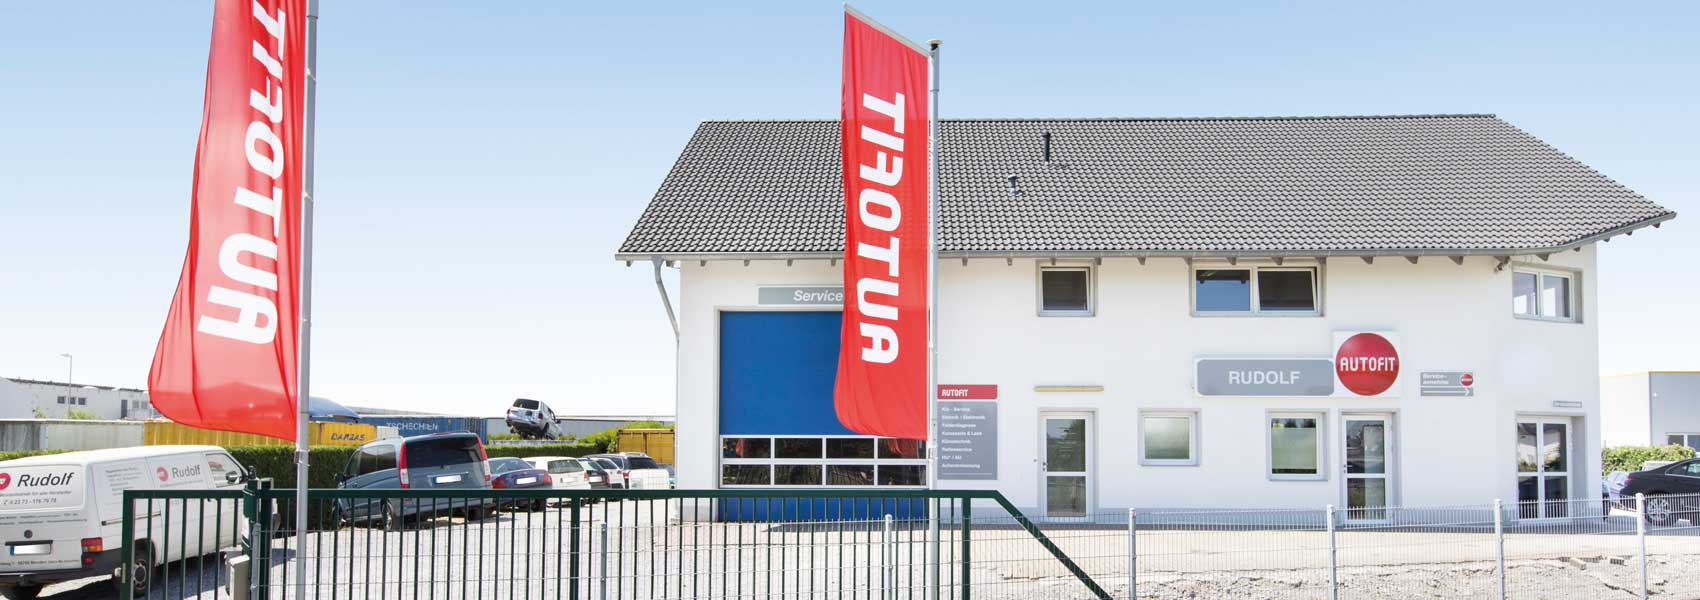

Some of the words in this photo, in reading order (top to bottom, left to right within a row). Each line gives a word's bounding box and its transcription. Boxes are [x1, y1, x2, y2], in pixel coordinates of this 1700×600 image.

[792, 289, 844, 302] Service
[1340, 357, 1396, 372] AUTOFIT
[1228, 370, 1301, 385] RUDOLF
[941, 389, 968, 397] AUTOFIT
[171, 464, 201, 479] Rudolf
[17, 472, 75, 488] Rudolf
